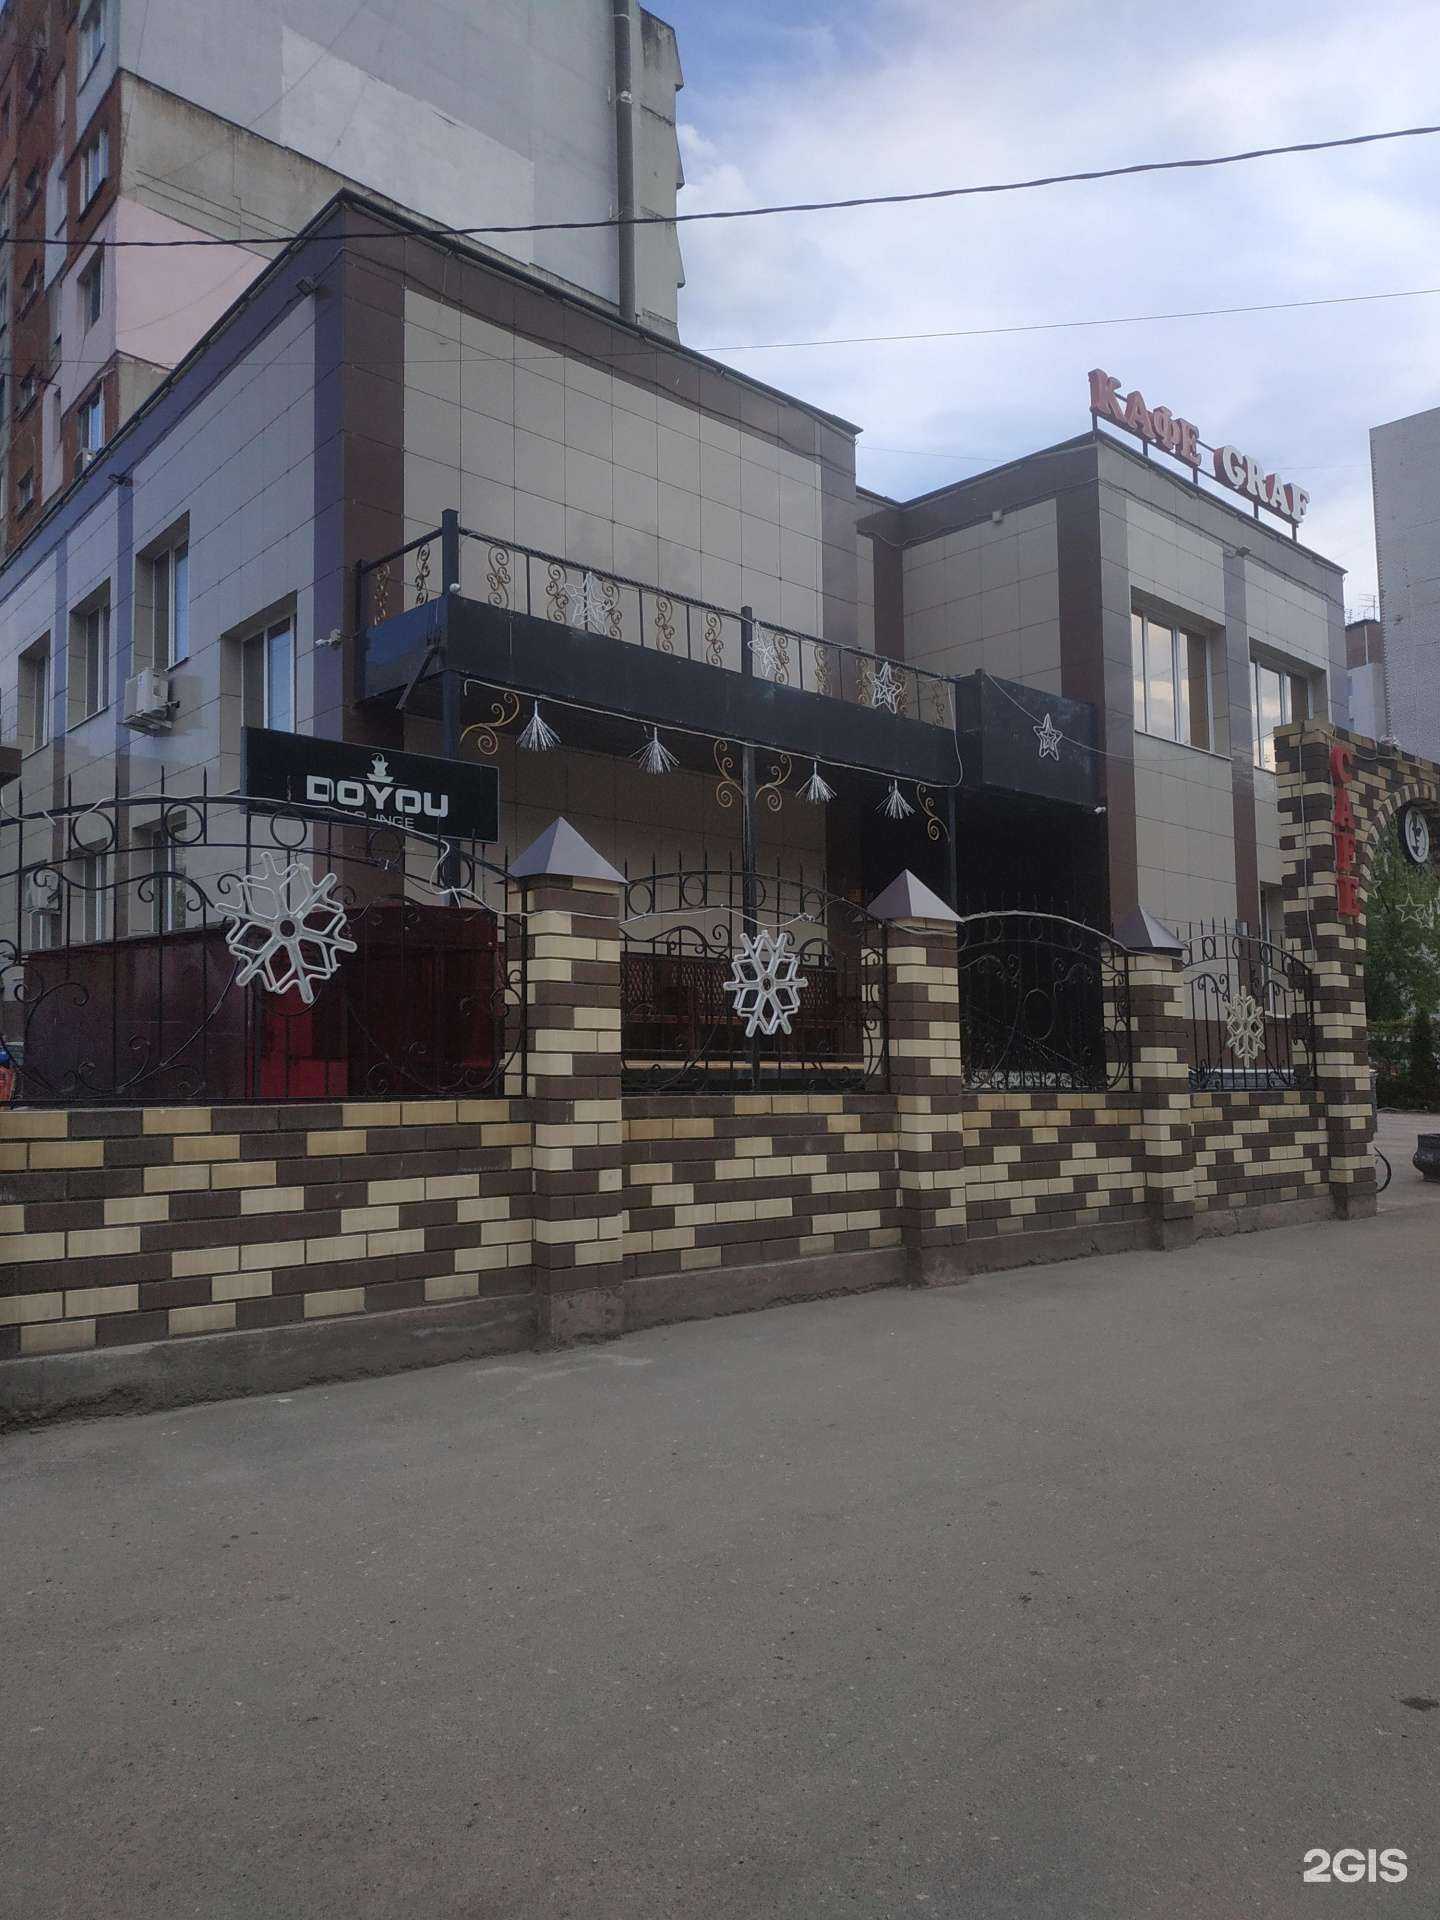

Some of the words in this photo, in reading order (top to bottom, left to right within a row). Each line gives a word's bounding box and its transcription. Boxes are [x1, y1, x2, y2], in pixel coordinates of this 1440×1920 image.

[1088, 368, 1201, 467] КАФЕ
[1213, 445, 1310, 523] GRAF
[1330, 744, 1361, 917] CAFE
